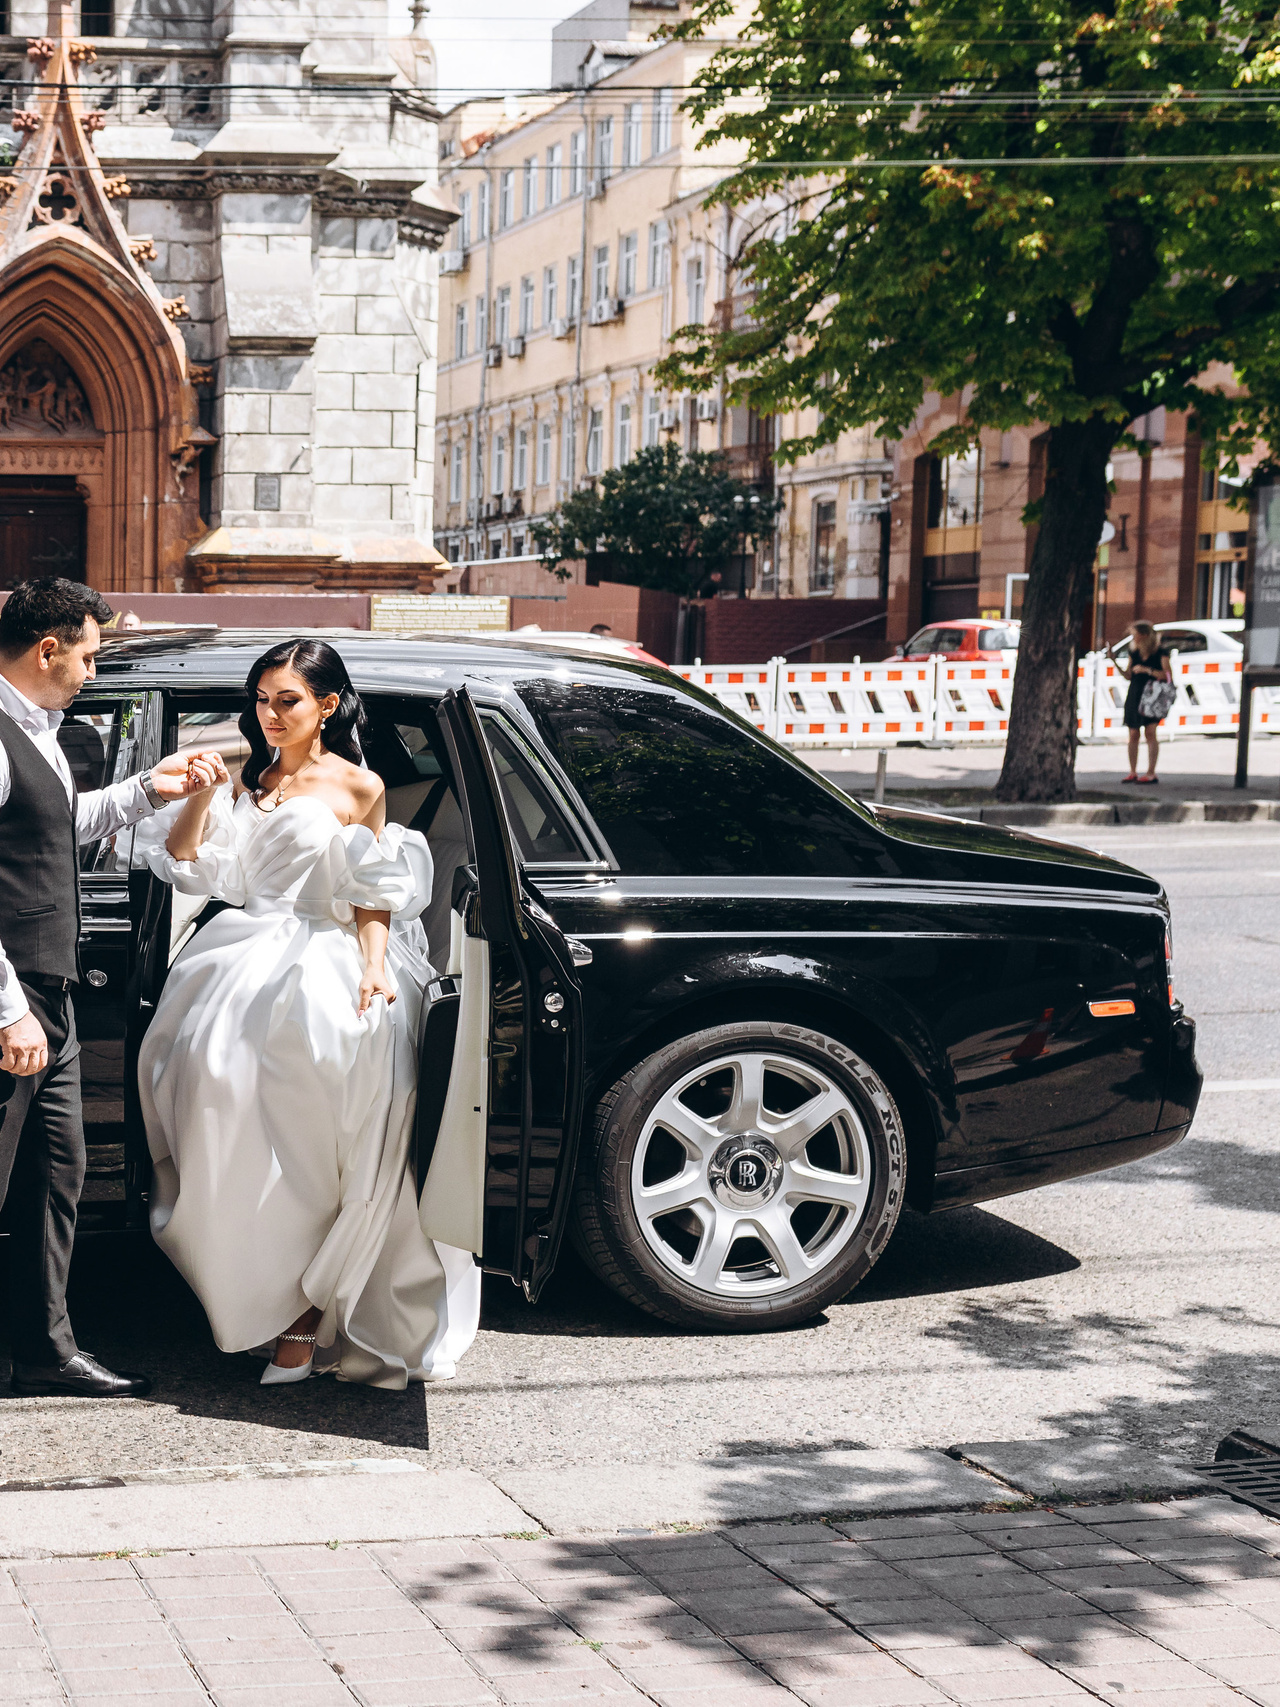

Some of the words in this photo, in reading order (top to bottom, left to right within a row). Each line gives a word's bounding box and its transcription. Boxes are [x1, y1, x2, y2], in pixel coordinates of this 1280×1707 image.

[777, 1023, 882, 1096] EAGLE
[880, 1108, 903, 1179] NCT
[738, 1160, 757, 1187] RR
[886, 1187, 900, 1205] 5
